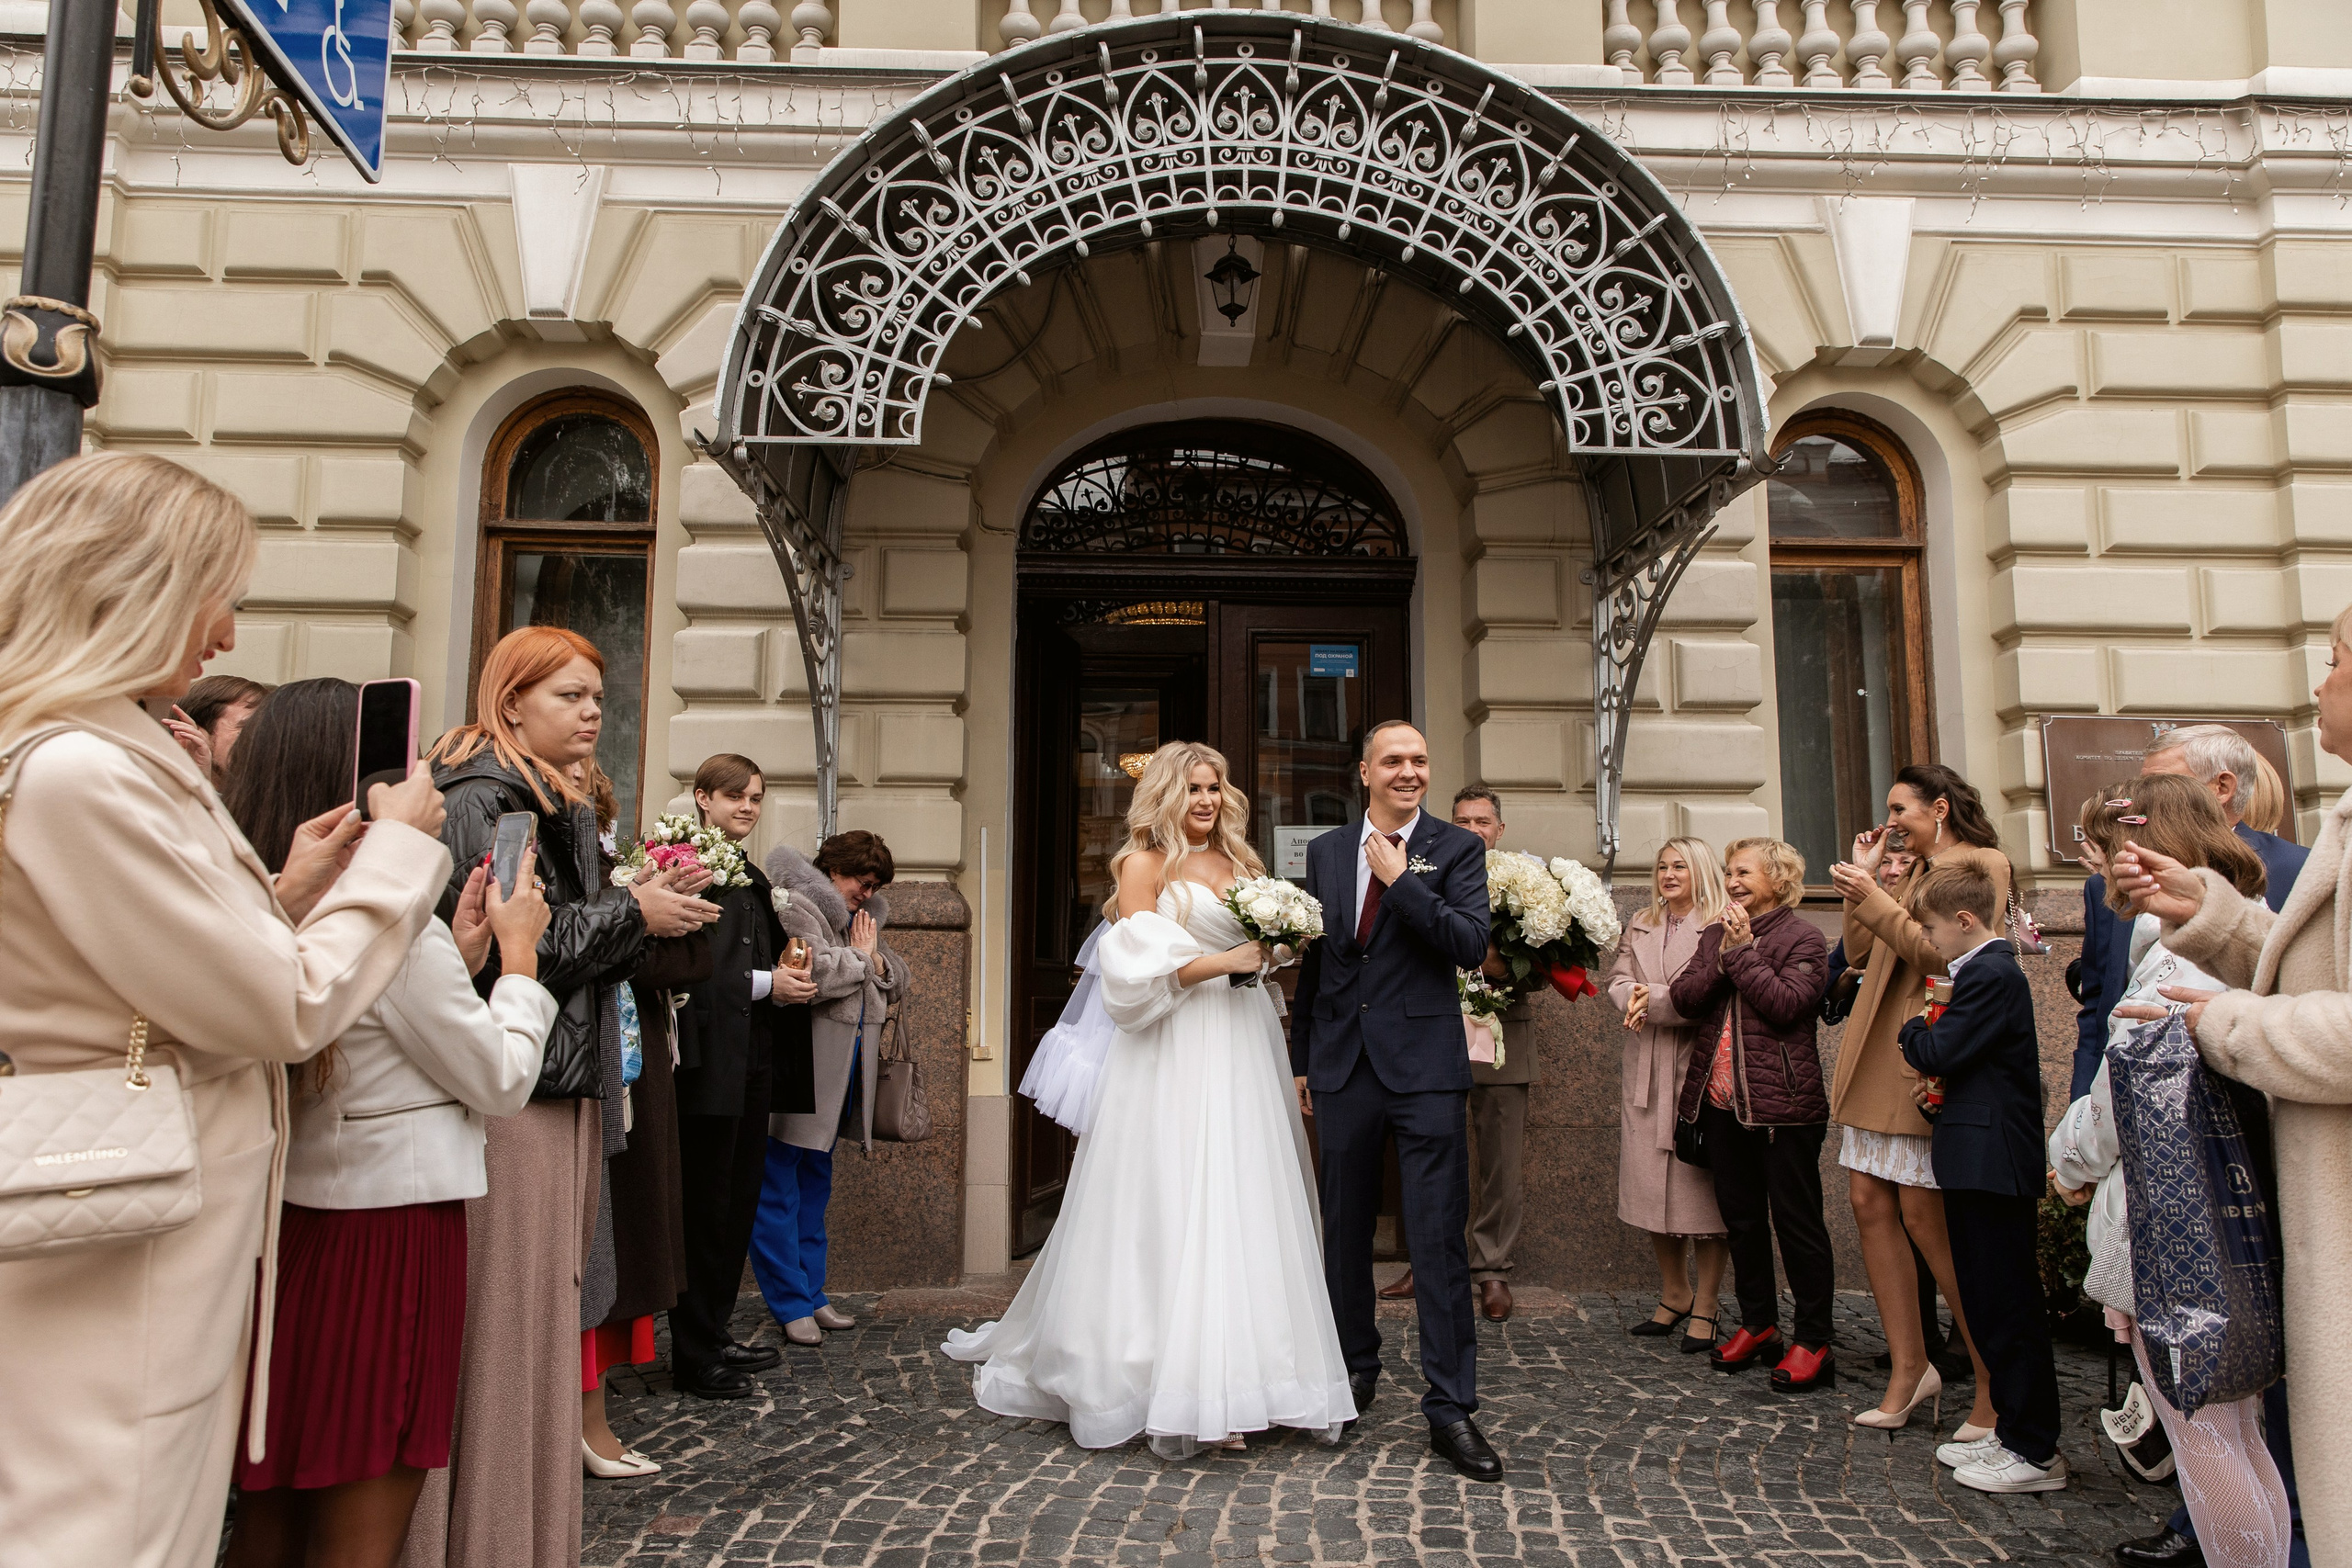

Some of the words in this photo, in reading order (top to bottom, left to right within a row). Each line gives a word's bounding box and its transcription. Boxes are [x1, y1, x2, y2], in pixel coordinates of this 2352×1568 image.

[34, 1147, 128, 1166] VALENTINO
[2112, 1401, 2140, 1427] HELLO
[2122, 1413, 2144, 1434] Girl
